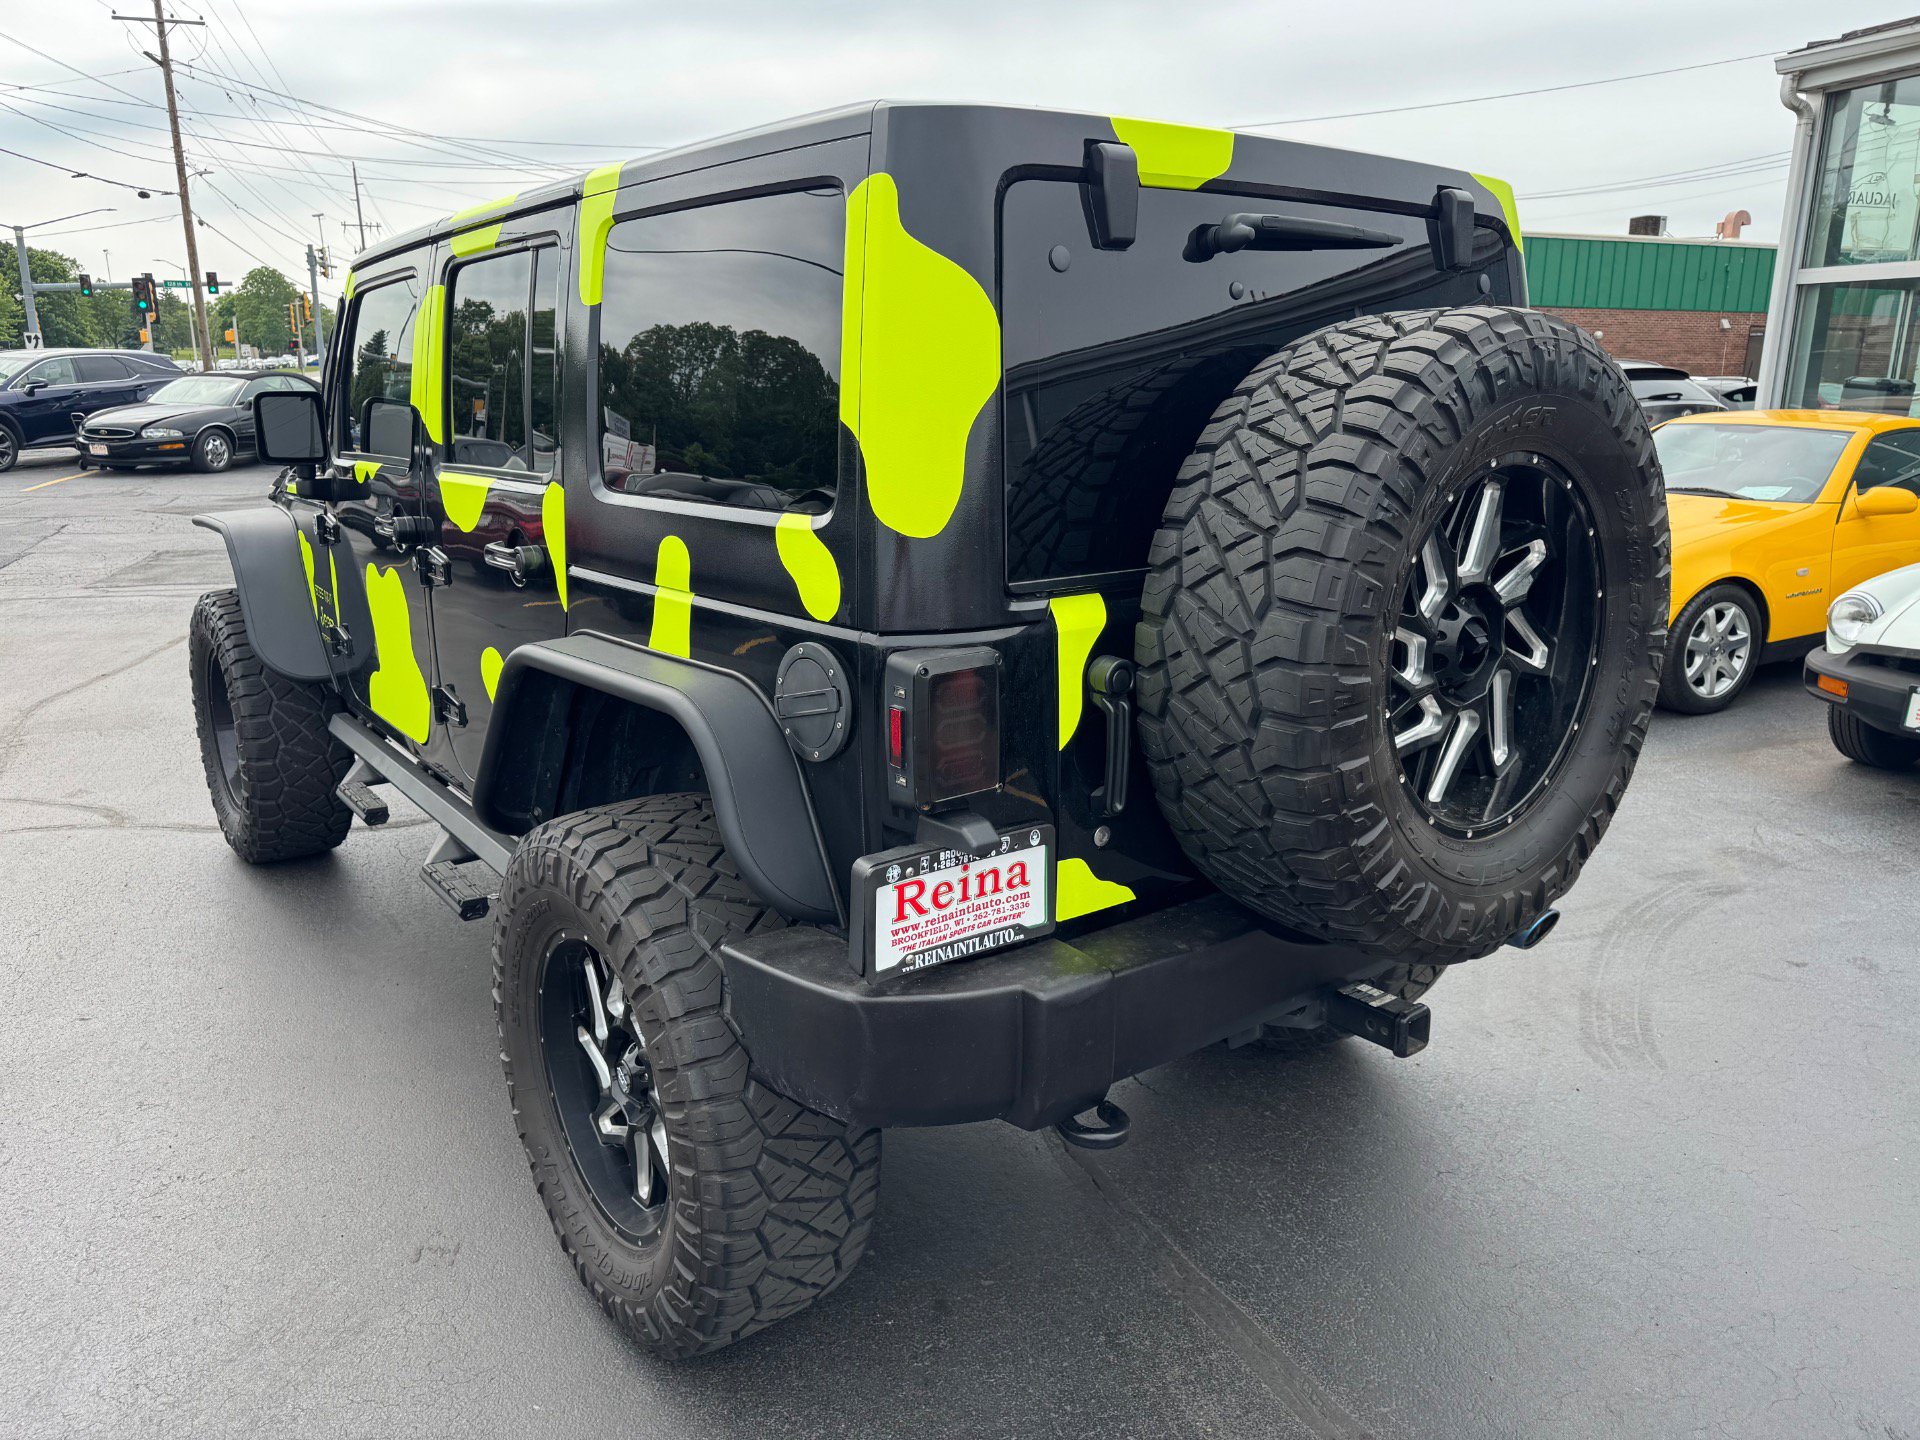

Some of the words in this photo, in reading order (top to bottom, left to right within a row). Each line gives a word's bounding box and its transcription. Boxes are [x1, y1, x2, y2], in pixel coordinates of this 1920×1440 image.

[891, 860, 1031, 925] Reina
[891, 891, 1031, 938] www.reinaintlauto.com
[891, 923, 952, 947] BROOKFIELD,
[954, 917, 965, 927] WI
[973, 900, 1030, 921] 262-781-3336
[919, 933, 948, 948] ITALIAN
[949, 925, 976, 939] SPORTS
[977, 919, 992, 929] CAR
